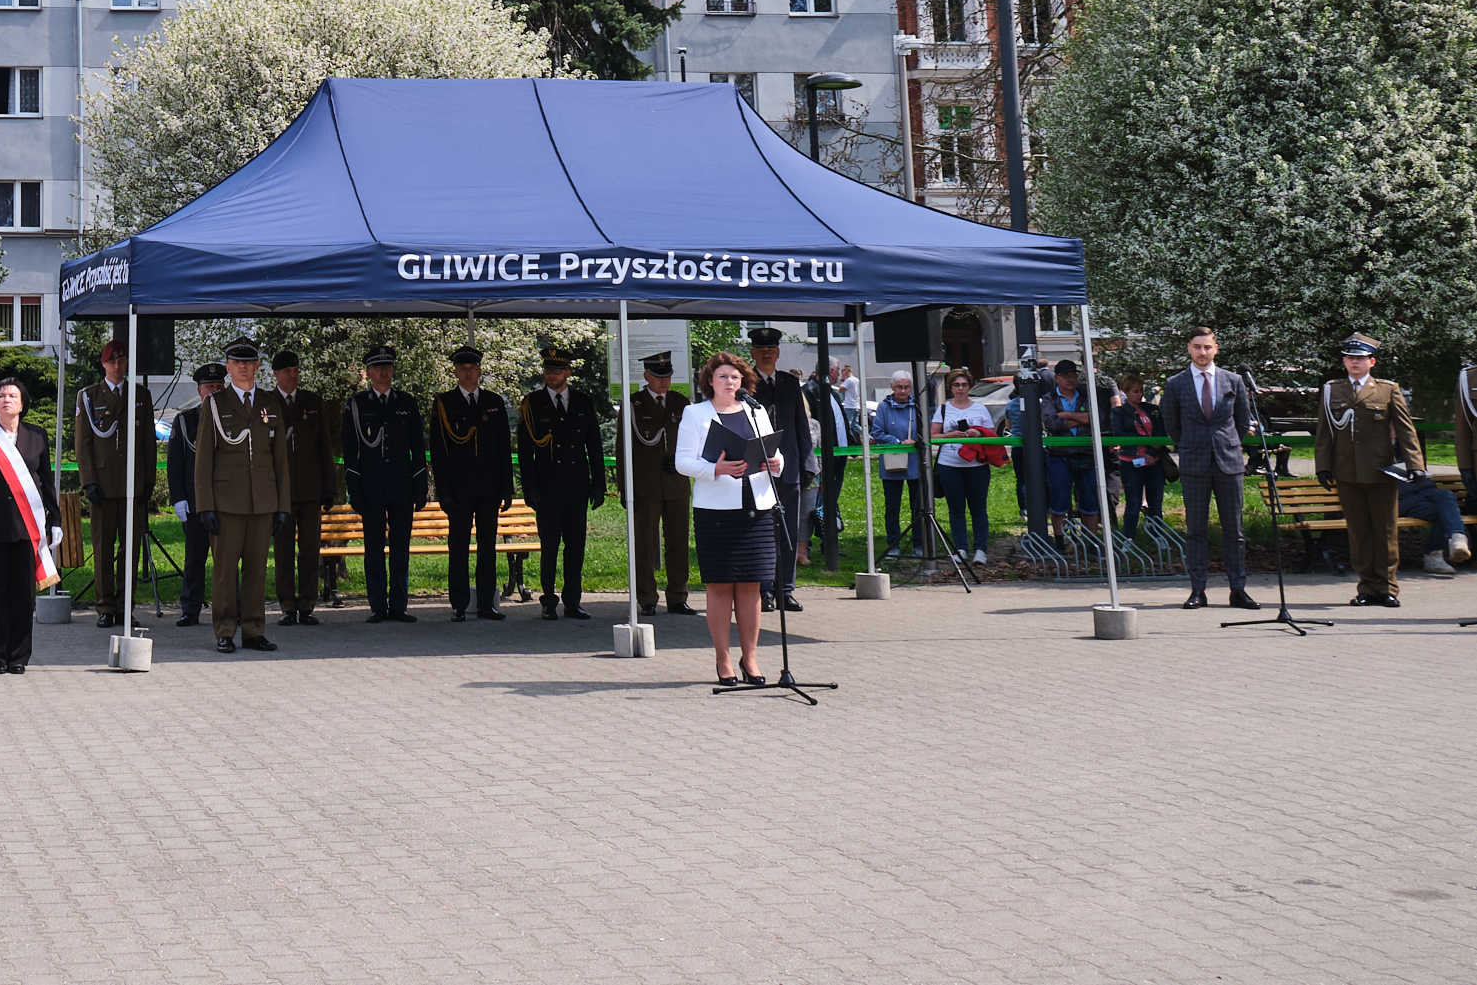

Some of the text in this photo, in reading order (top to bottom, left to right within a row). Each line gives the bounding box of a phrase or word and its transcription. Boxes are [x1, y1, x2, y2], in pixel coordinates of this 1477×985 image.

[397, 251, 844, 288] GLIWICE. Przyszłość jest tu
